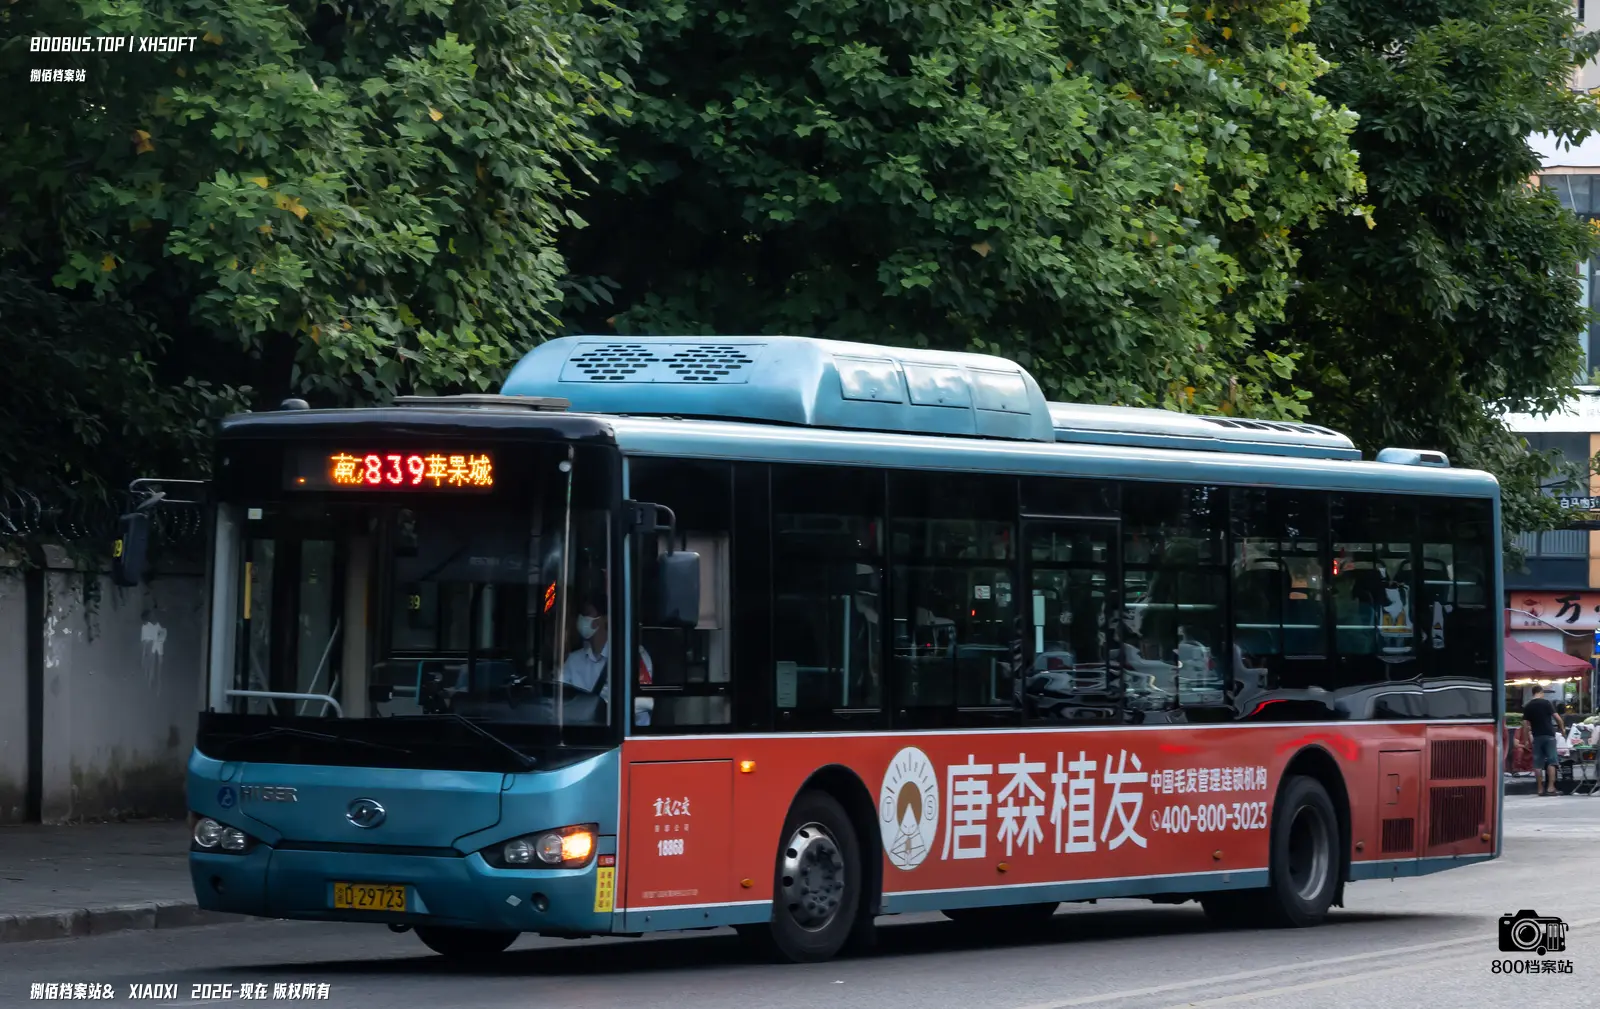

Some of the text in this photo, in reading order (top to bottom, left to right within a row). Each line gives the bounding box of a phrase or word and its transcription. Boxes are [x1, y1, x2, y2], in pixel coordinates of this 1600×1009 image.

[1151, 766, 1267, 794] 中国毛发管理连锁机构
[941, 749, 1149, 860] 唐森植发
[1161, 802, 1267, 833] 400-800-3023
